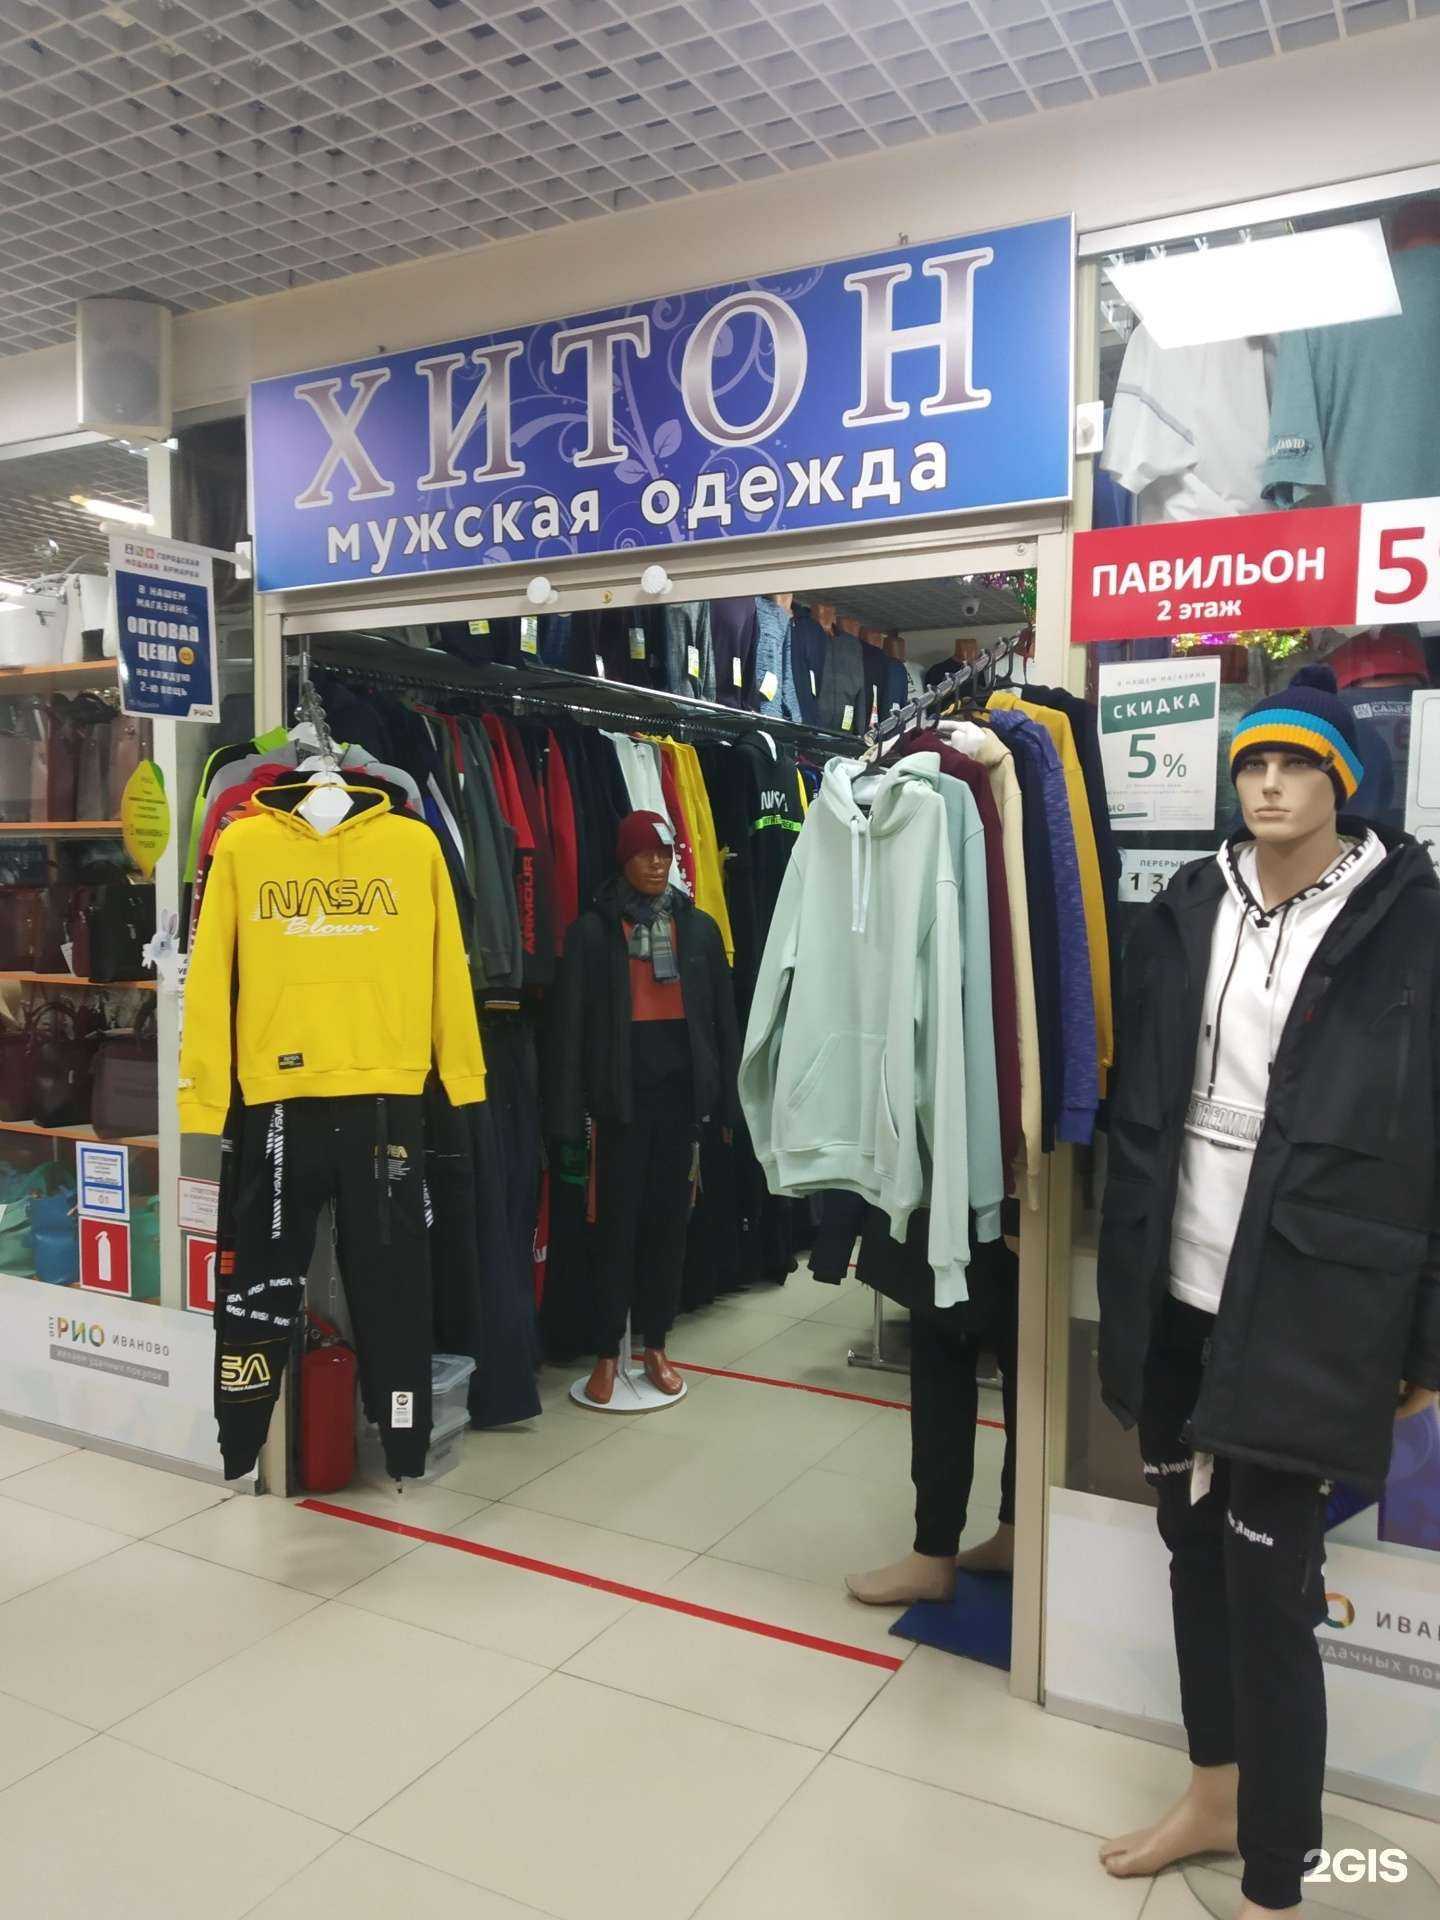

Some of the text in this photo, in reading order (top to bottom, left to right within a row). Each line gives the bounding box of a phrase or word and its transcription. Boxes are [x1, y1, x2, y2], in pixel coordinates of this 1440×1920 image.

[294, 246, 994, 510] ХИТОН
[327, 440, 948, 575] мужская одежда
[1092, 547, 1326, 597] ПАВИЛЬОН
[1374, 526, 1440, 605] 5
[136, 598, 189, 615] МАГАЗИНЕ
[138, 584, 186, 601] В НАШЕМ
[1156, 599, 1242, 621] 2 этаж
[127, 616, 199, 642] ОПТОВАЯ
[137, 641, 177, 662] ЦЕНА
[140, 681, 188, 697] 2-ю вещь
[150, 670, 191, 683] каждую
[1113, 693, 1201, 719] СКИДКА
[1127, 733, 1187, 779] 5 %
[260, 878, 398, 919] NASA
[57, 1317, 105, 1347] РИО
[113, 1334, 170, 1356] ИВАНОВО
[1376, 1610, 1440, 1641] ИВА
